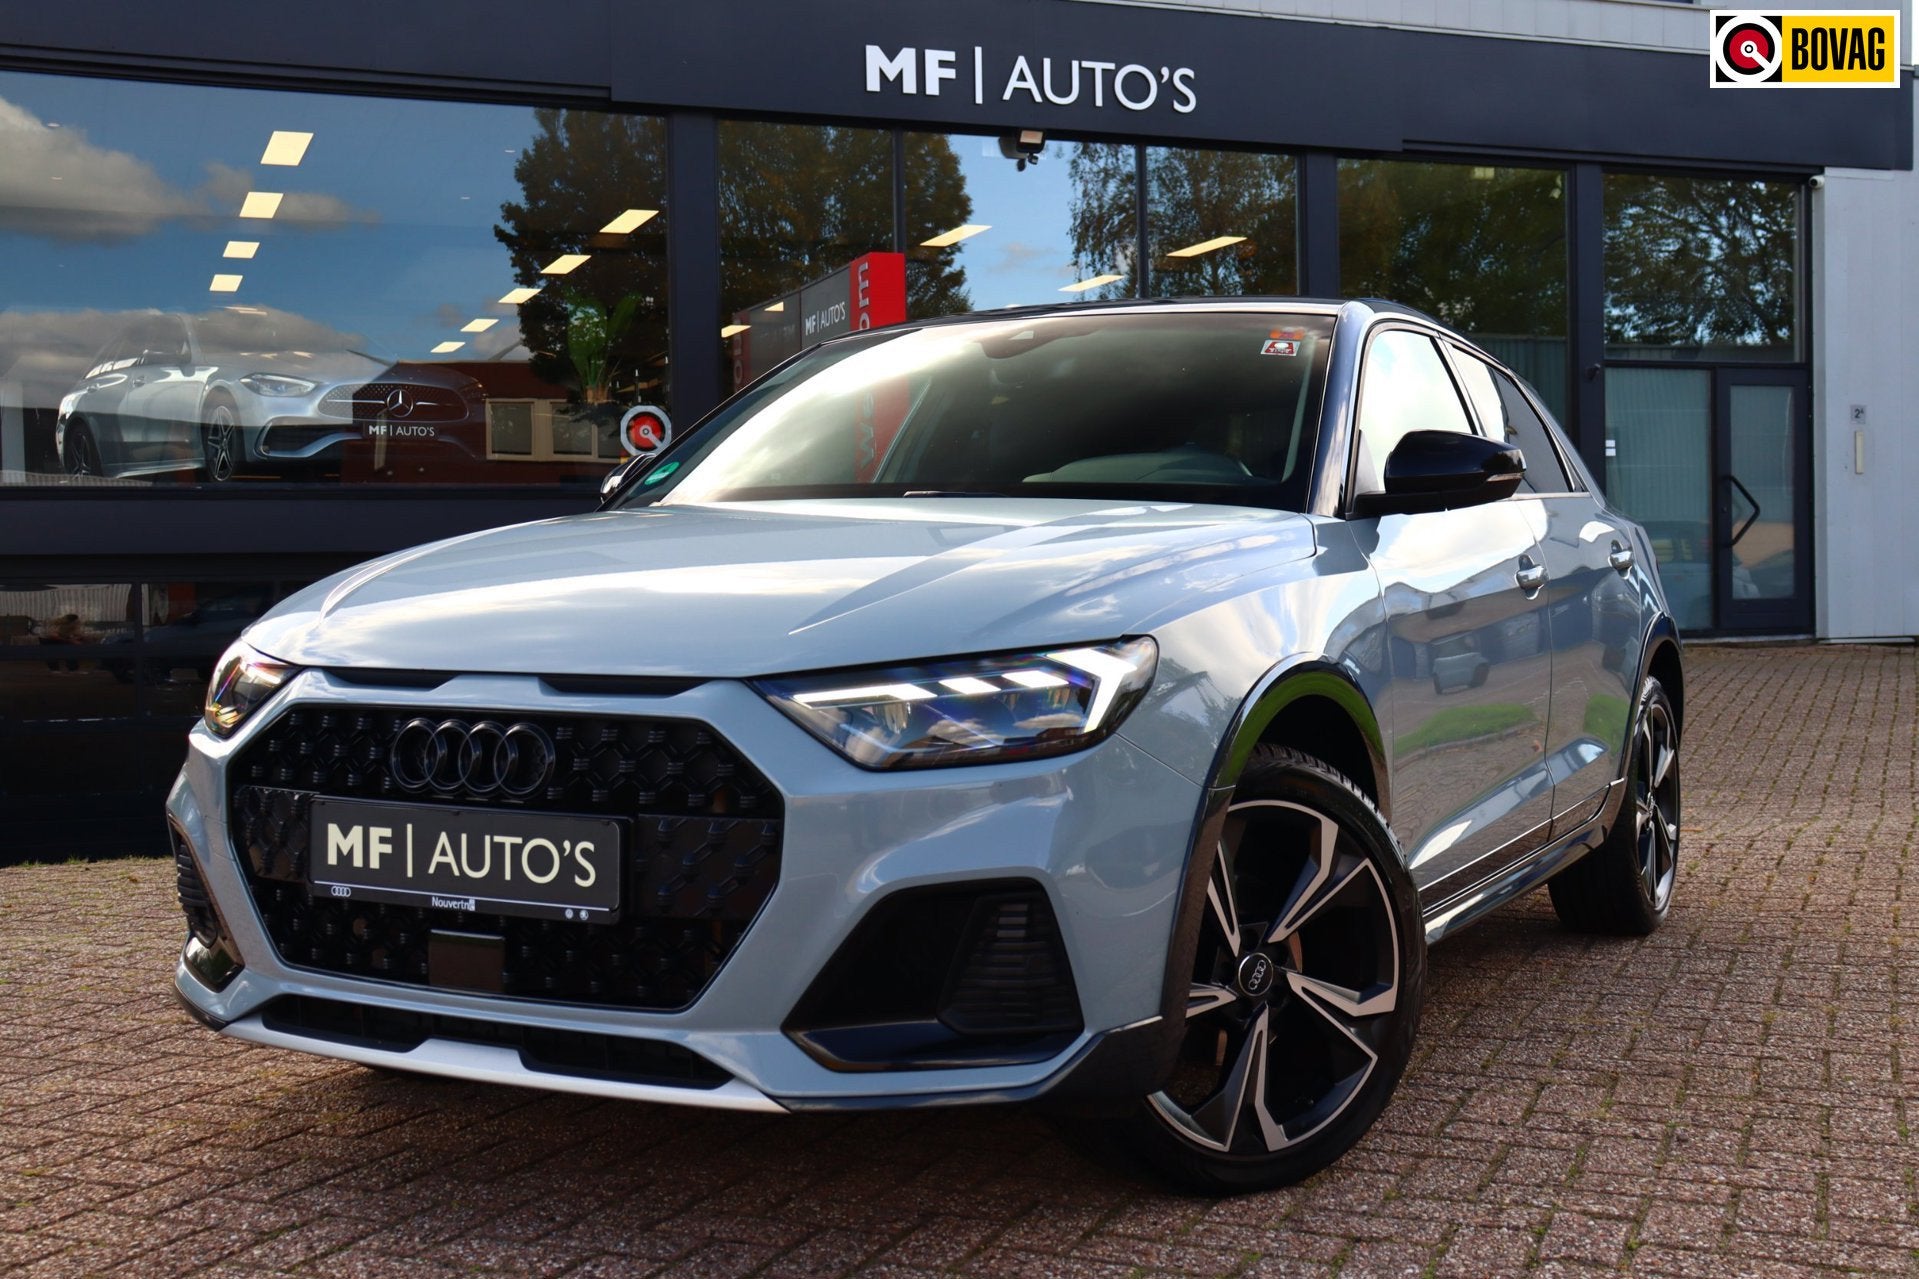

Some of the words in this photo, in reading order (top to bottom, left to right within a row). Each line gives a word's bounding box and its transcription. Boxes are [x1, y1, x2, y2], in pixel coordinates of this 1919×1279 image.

[865, 44, 956, 96] MF
[1002, 55, 1197, 113] AUTO'S
[804, 315, 816, 336] MF
[818, 301, 847, 329] AUTO'S
[368, 424, 388, 436] MF
[395, 425, 436, 437] AUTO'S
[327, 822, 393, 870] MF
[427, 831, 597, 888] AUTO'S
